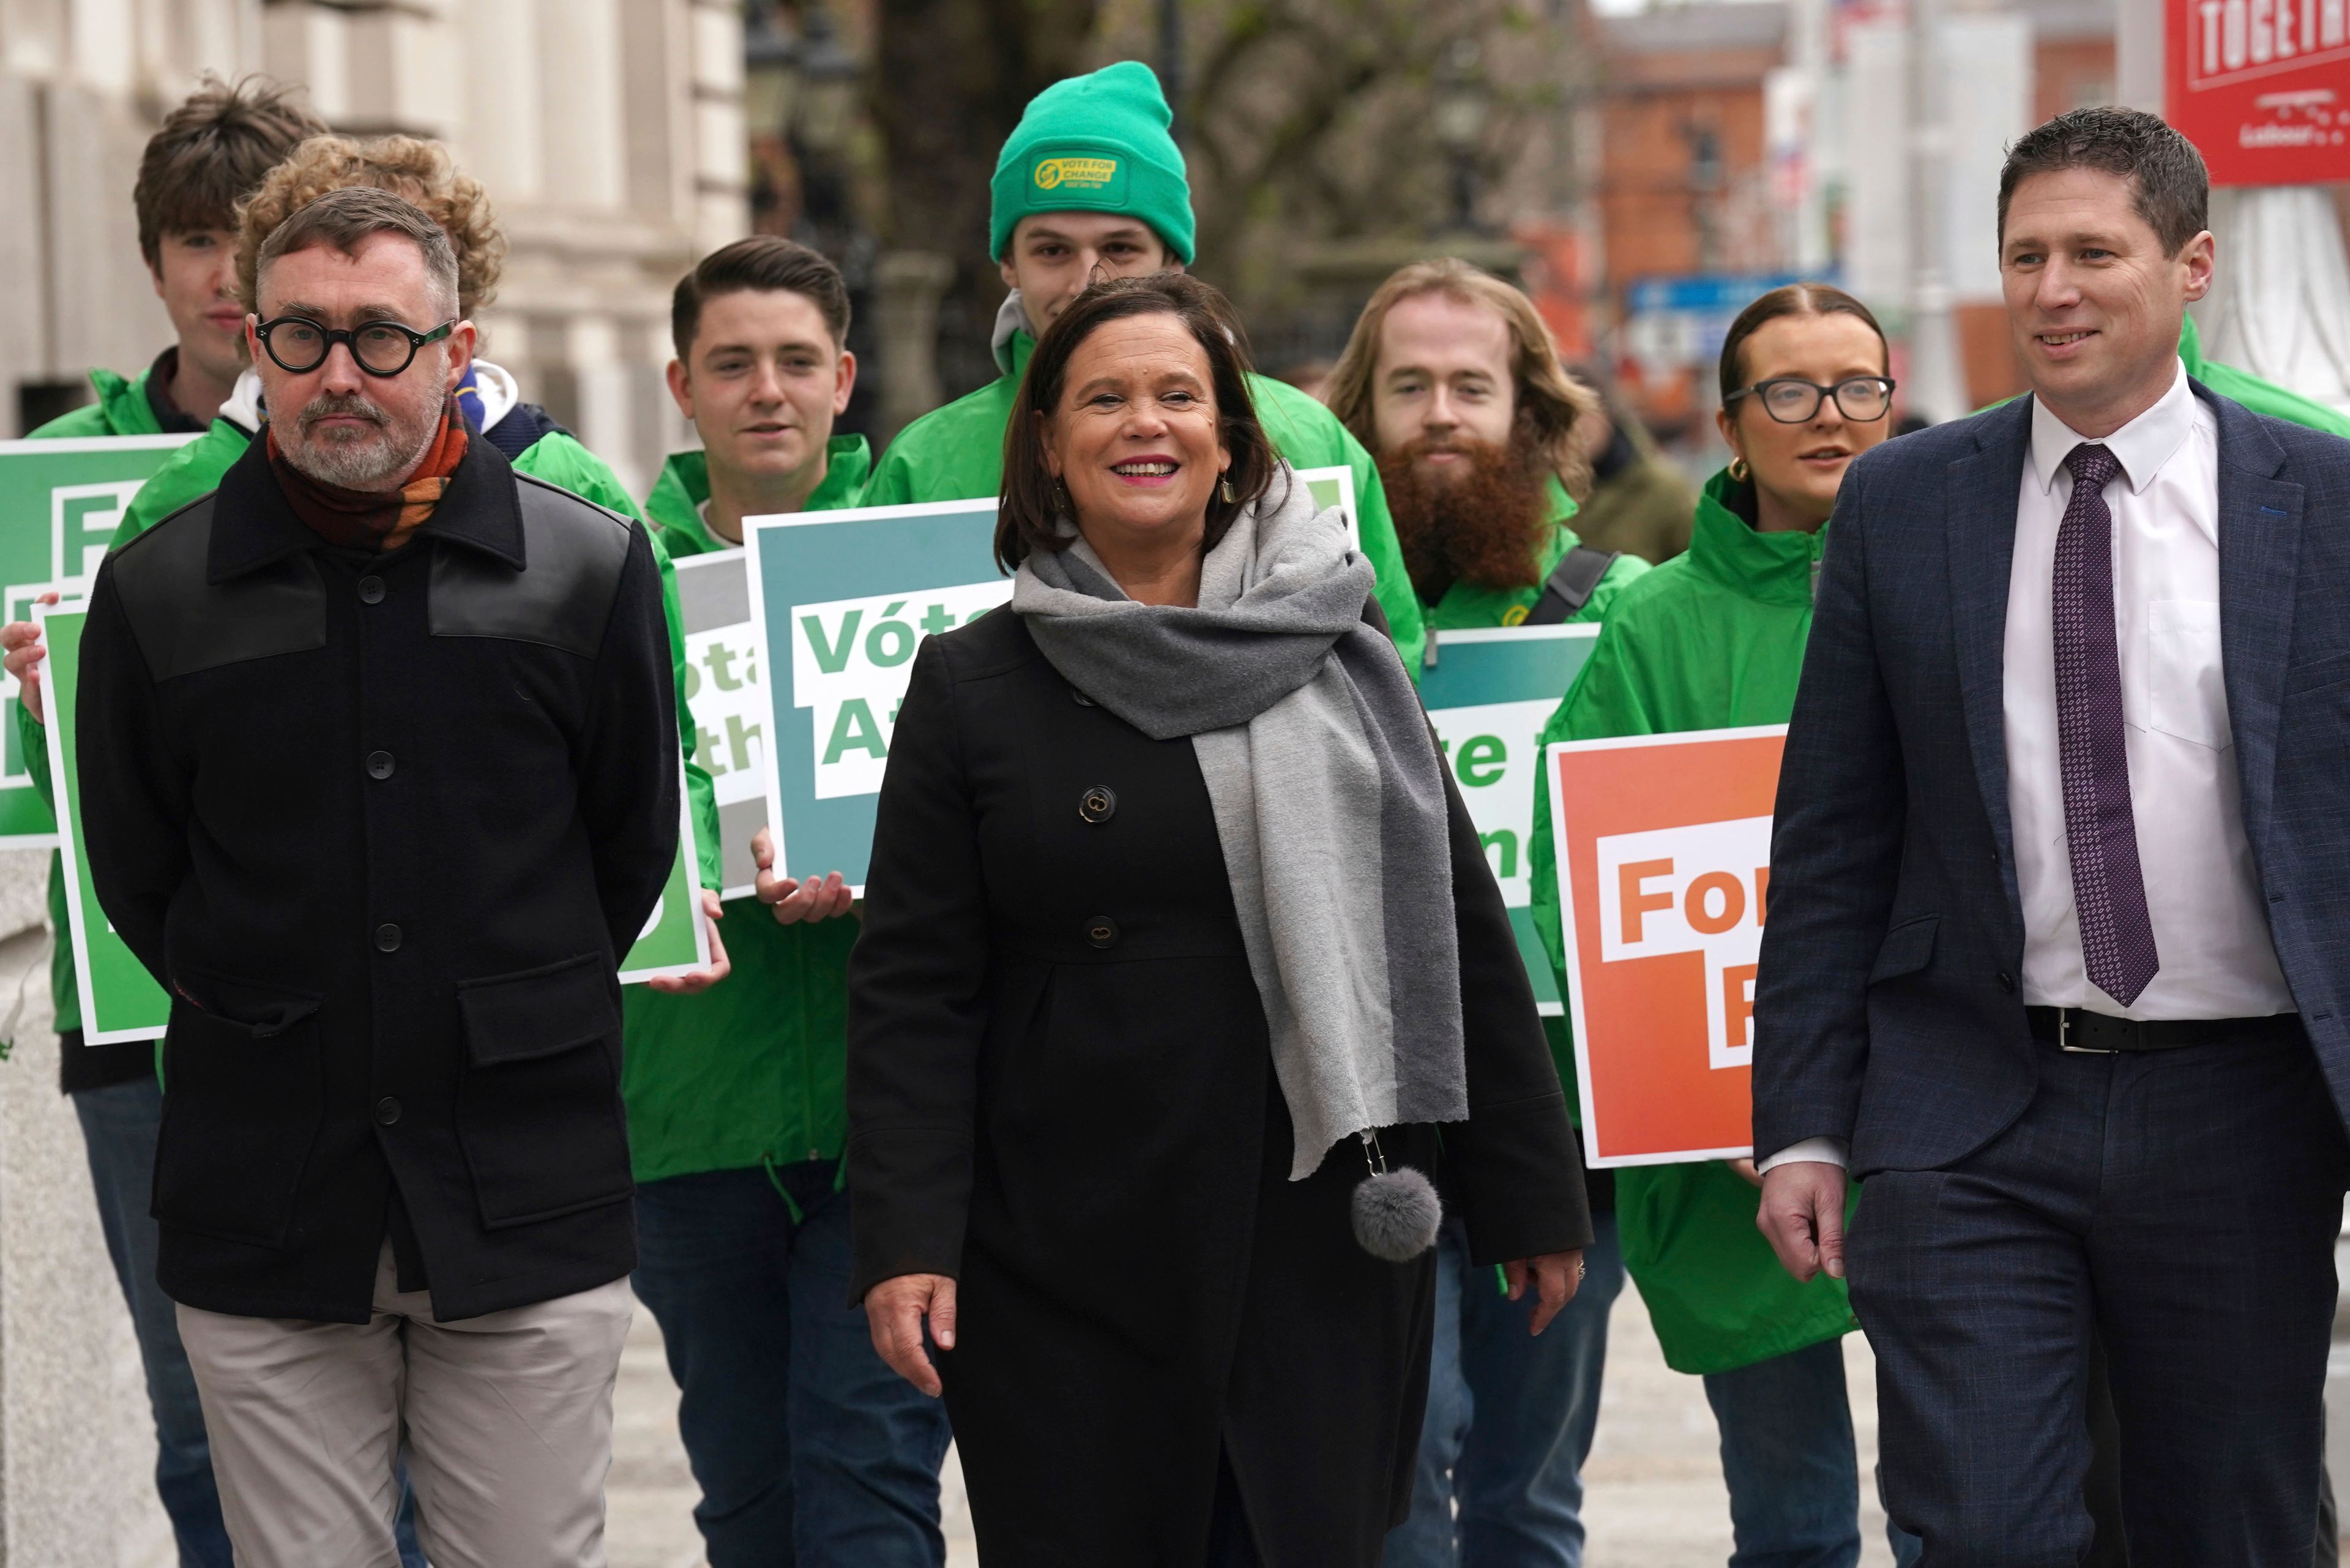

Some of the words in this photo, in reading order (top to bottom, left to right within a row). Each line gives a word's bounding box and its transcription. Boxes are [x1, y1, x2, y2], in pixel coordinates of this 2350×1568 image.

[2201, 0, 2350, 74] TOGETH
[1063, 171, 1108, 179] CHANGE
[800, 600, 993, 674] Vót
